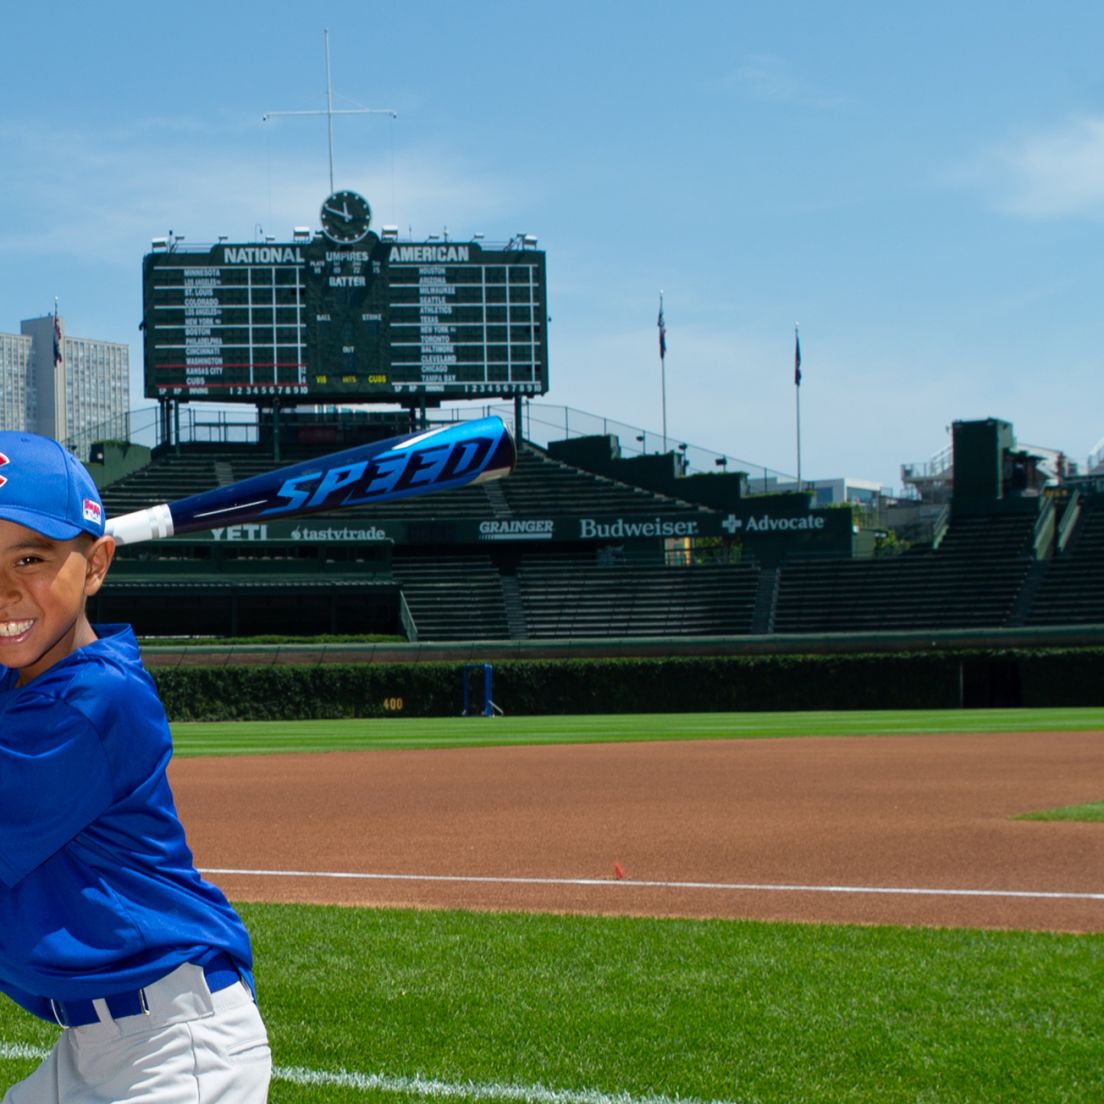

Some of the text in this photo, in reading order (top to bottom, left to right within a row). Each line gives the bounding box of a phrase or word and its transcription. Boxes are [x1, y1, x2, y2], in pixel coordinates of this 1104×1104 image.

[224, 247, 305, 264] NATIONAL
[325, 251, 369, 262] UMPIRES
[388, 246, 470, 262] AMERICAN
[328, 276, 366, 287] BATTER
[316, 313, 331, 321] BALL
[362, 313, 382, 321] STRIKE
[186, 377, 206, 385] CUBS
[368, 374, 387, 384] CUBS
[260, 437, 497, 516] SPEED
[479, 519, 554, 534] GRAINGER
[579, 518, 695, 538] Budweiser
[745, 513, 825, 532] Advocate
[211, 524, 267, 541] YETI
[383, 698, 403, 711] 400
